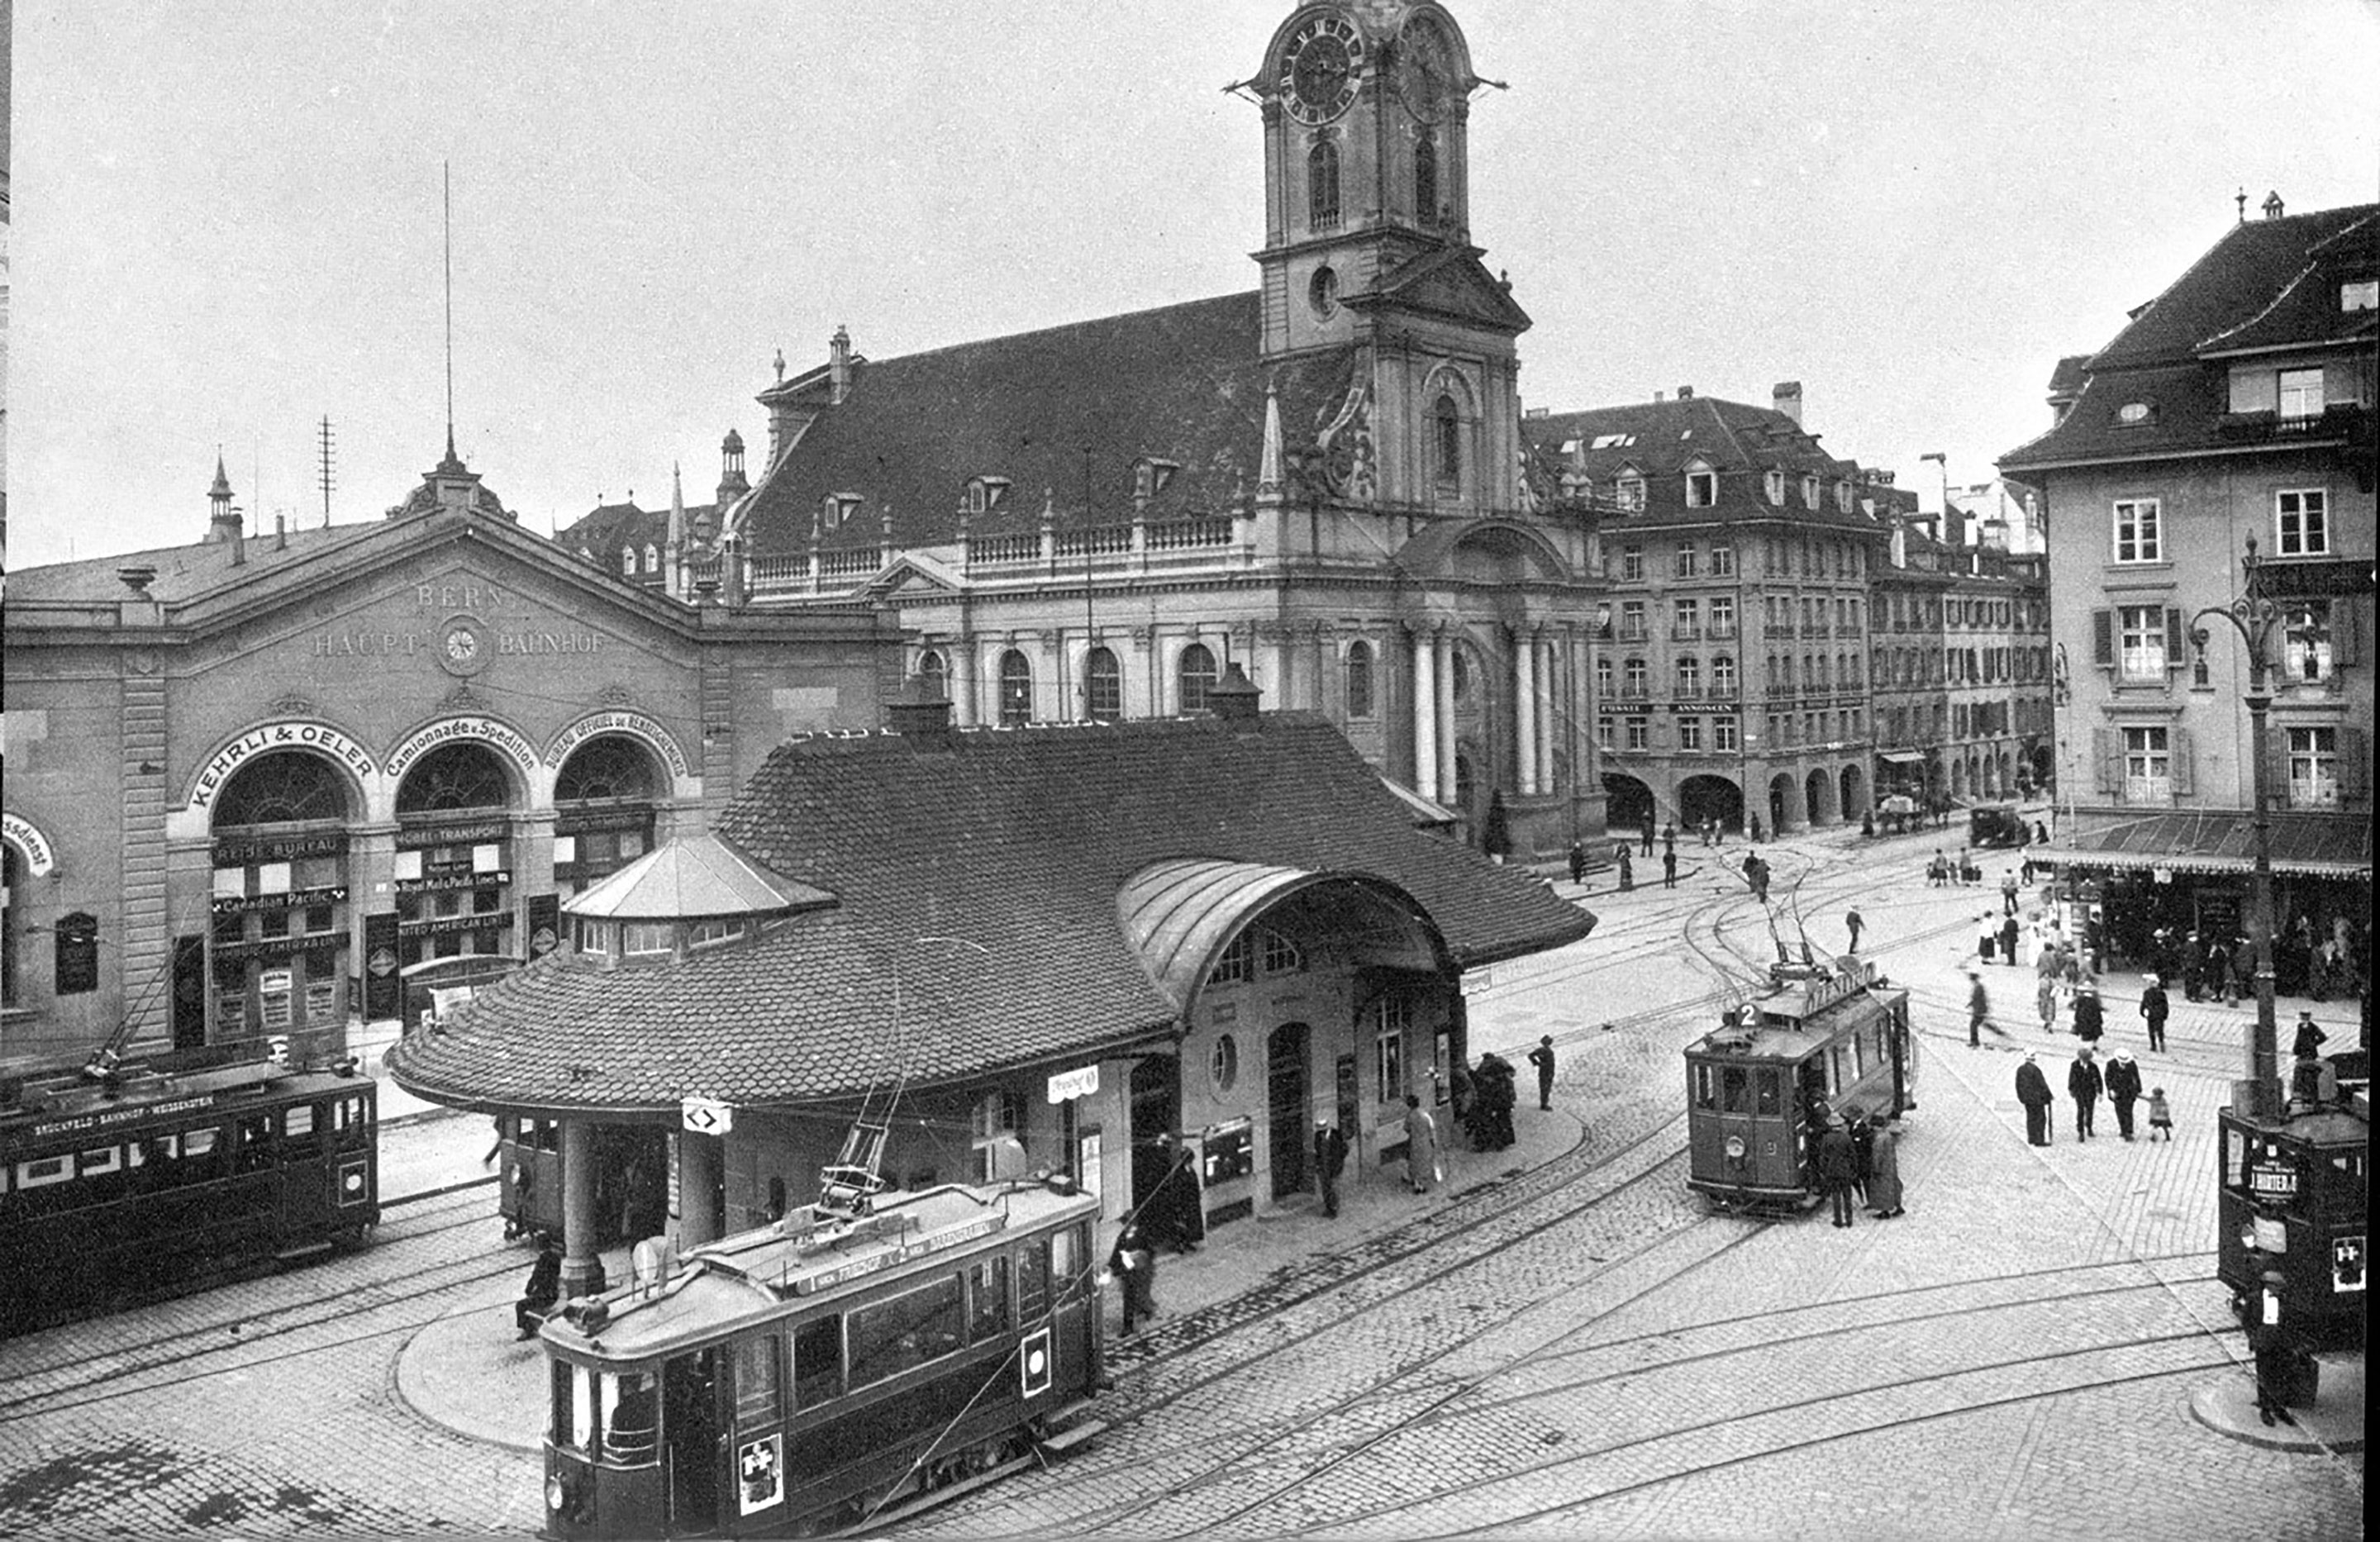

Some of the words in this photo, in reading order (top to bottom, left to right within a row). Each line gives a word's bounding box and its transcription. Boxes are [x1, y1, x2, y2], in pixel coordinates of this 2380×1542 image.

[417, 585, 502, 607] BERN
[313, 634, 416, 655] HAUPT
[499, 633, 604, 654] BAHNHOF
[387, 721, 469, 777] Camionnage
[479, 721, 536, 770] Spedition
[545, 731, 575, 770] BUREAU
[576, 715, 614, 737] OFFICIEL
[193, 731, 268, 808] KEHRLI
[275, 726, 293, 741] &
[302, 726, 372, 778] OELER
[223, 896, 283, 912] Canadian
[288, 891, 330, 905] Pacific
[1740, 1005, 1756, 1026] 2
[899, 1247, 907, 1264] 2
